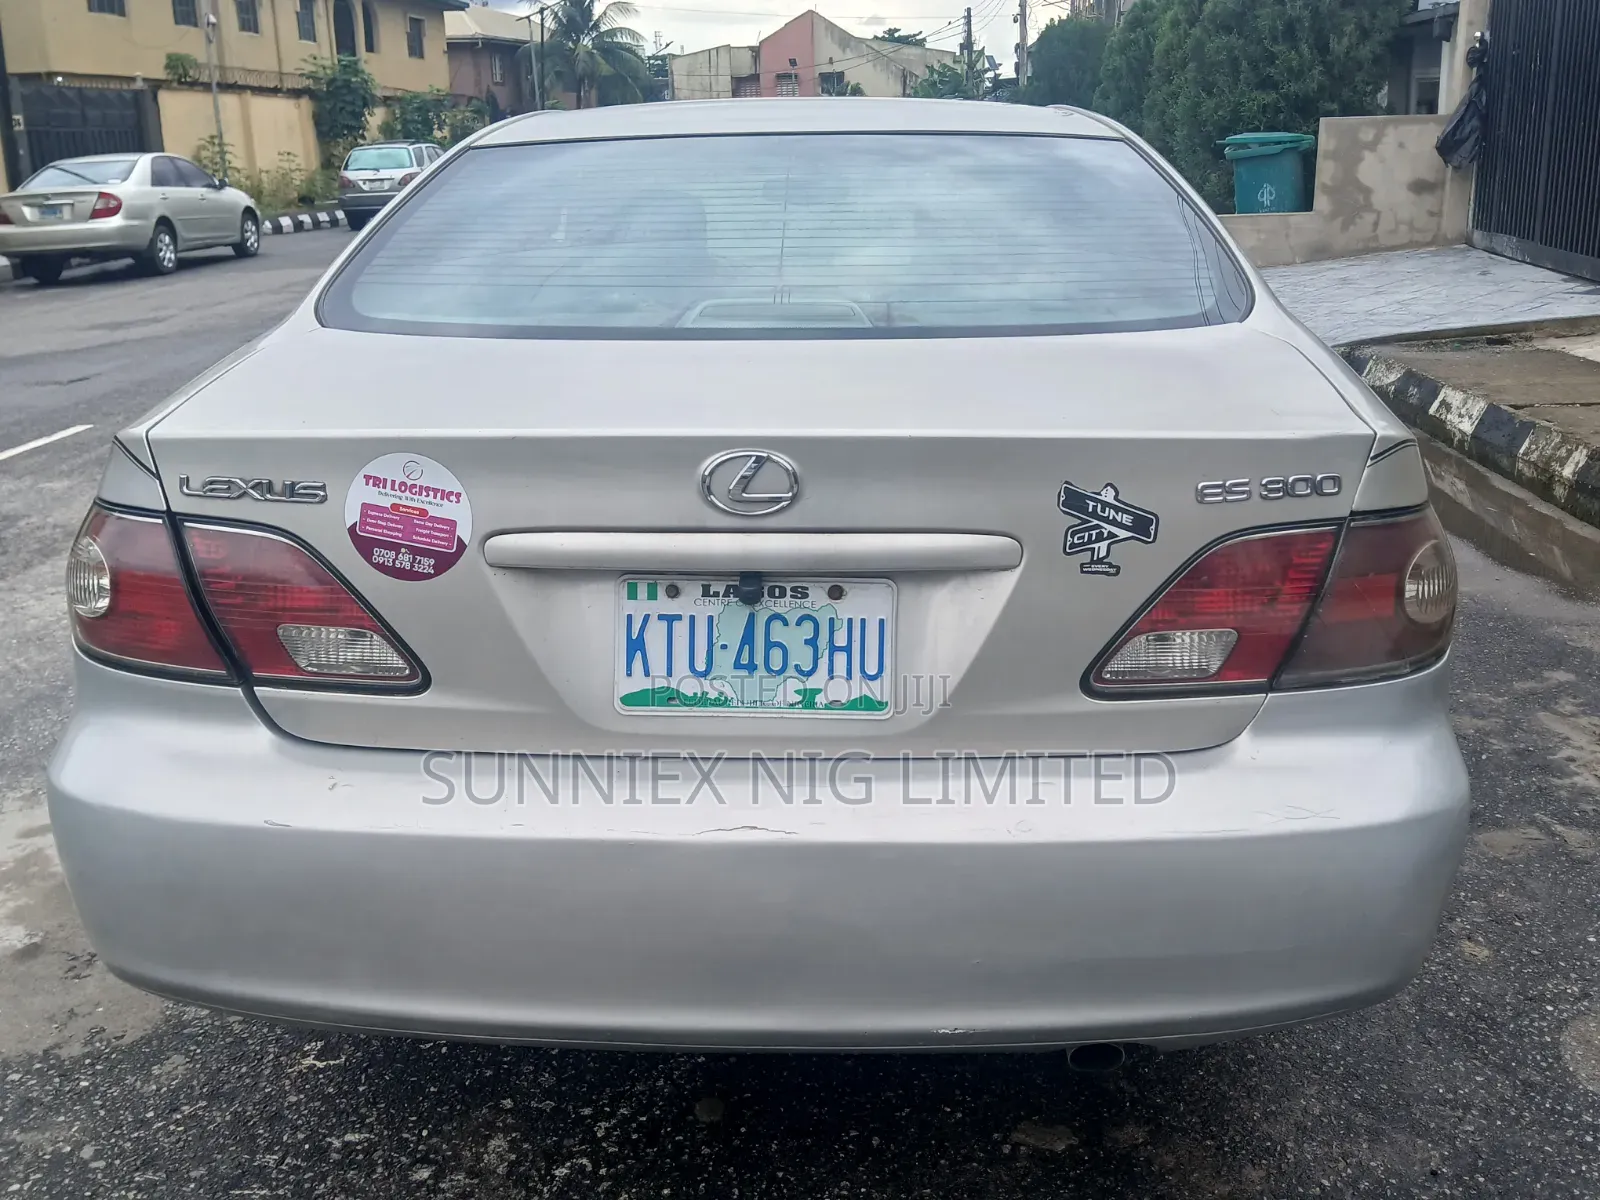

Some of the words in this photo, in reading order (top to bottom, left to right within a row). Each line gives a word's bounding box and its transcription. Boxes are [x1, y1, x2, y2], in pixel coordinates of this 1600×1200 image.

[179, 473, 327, 504] LEXUS
[363, 474, 387, 490] TRI
[390, 480, 462, 504] LOGISTICS
[378, 490, 403, 501] Delivering
[1195, 478, 1252, 505] ES
[1260, 472, 1342, 501] 300
[399, 506, 420, 515] Services
[1085, 500, 1135, 526] TUNE
[1072, 528, 1110, 544] CITY
[372, 555, 393, 567] 0913
[395, 560, 411, 570] 578
[412, 563, 435, 575] 3224
[373, 547, 396, 559] 0708
[397, 553, 412, 562] 681
[414, 555, 435, 566] 7159
[701, 584, 810, 600] LAOS
[693, 598, 732, 607] CENTRE
